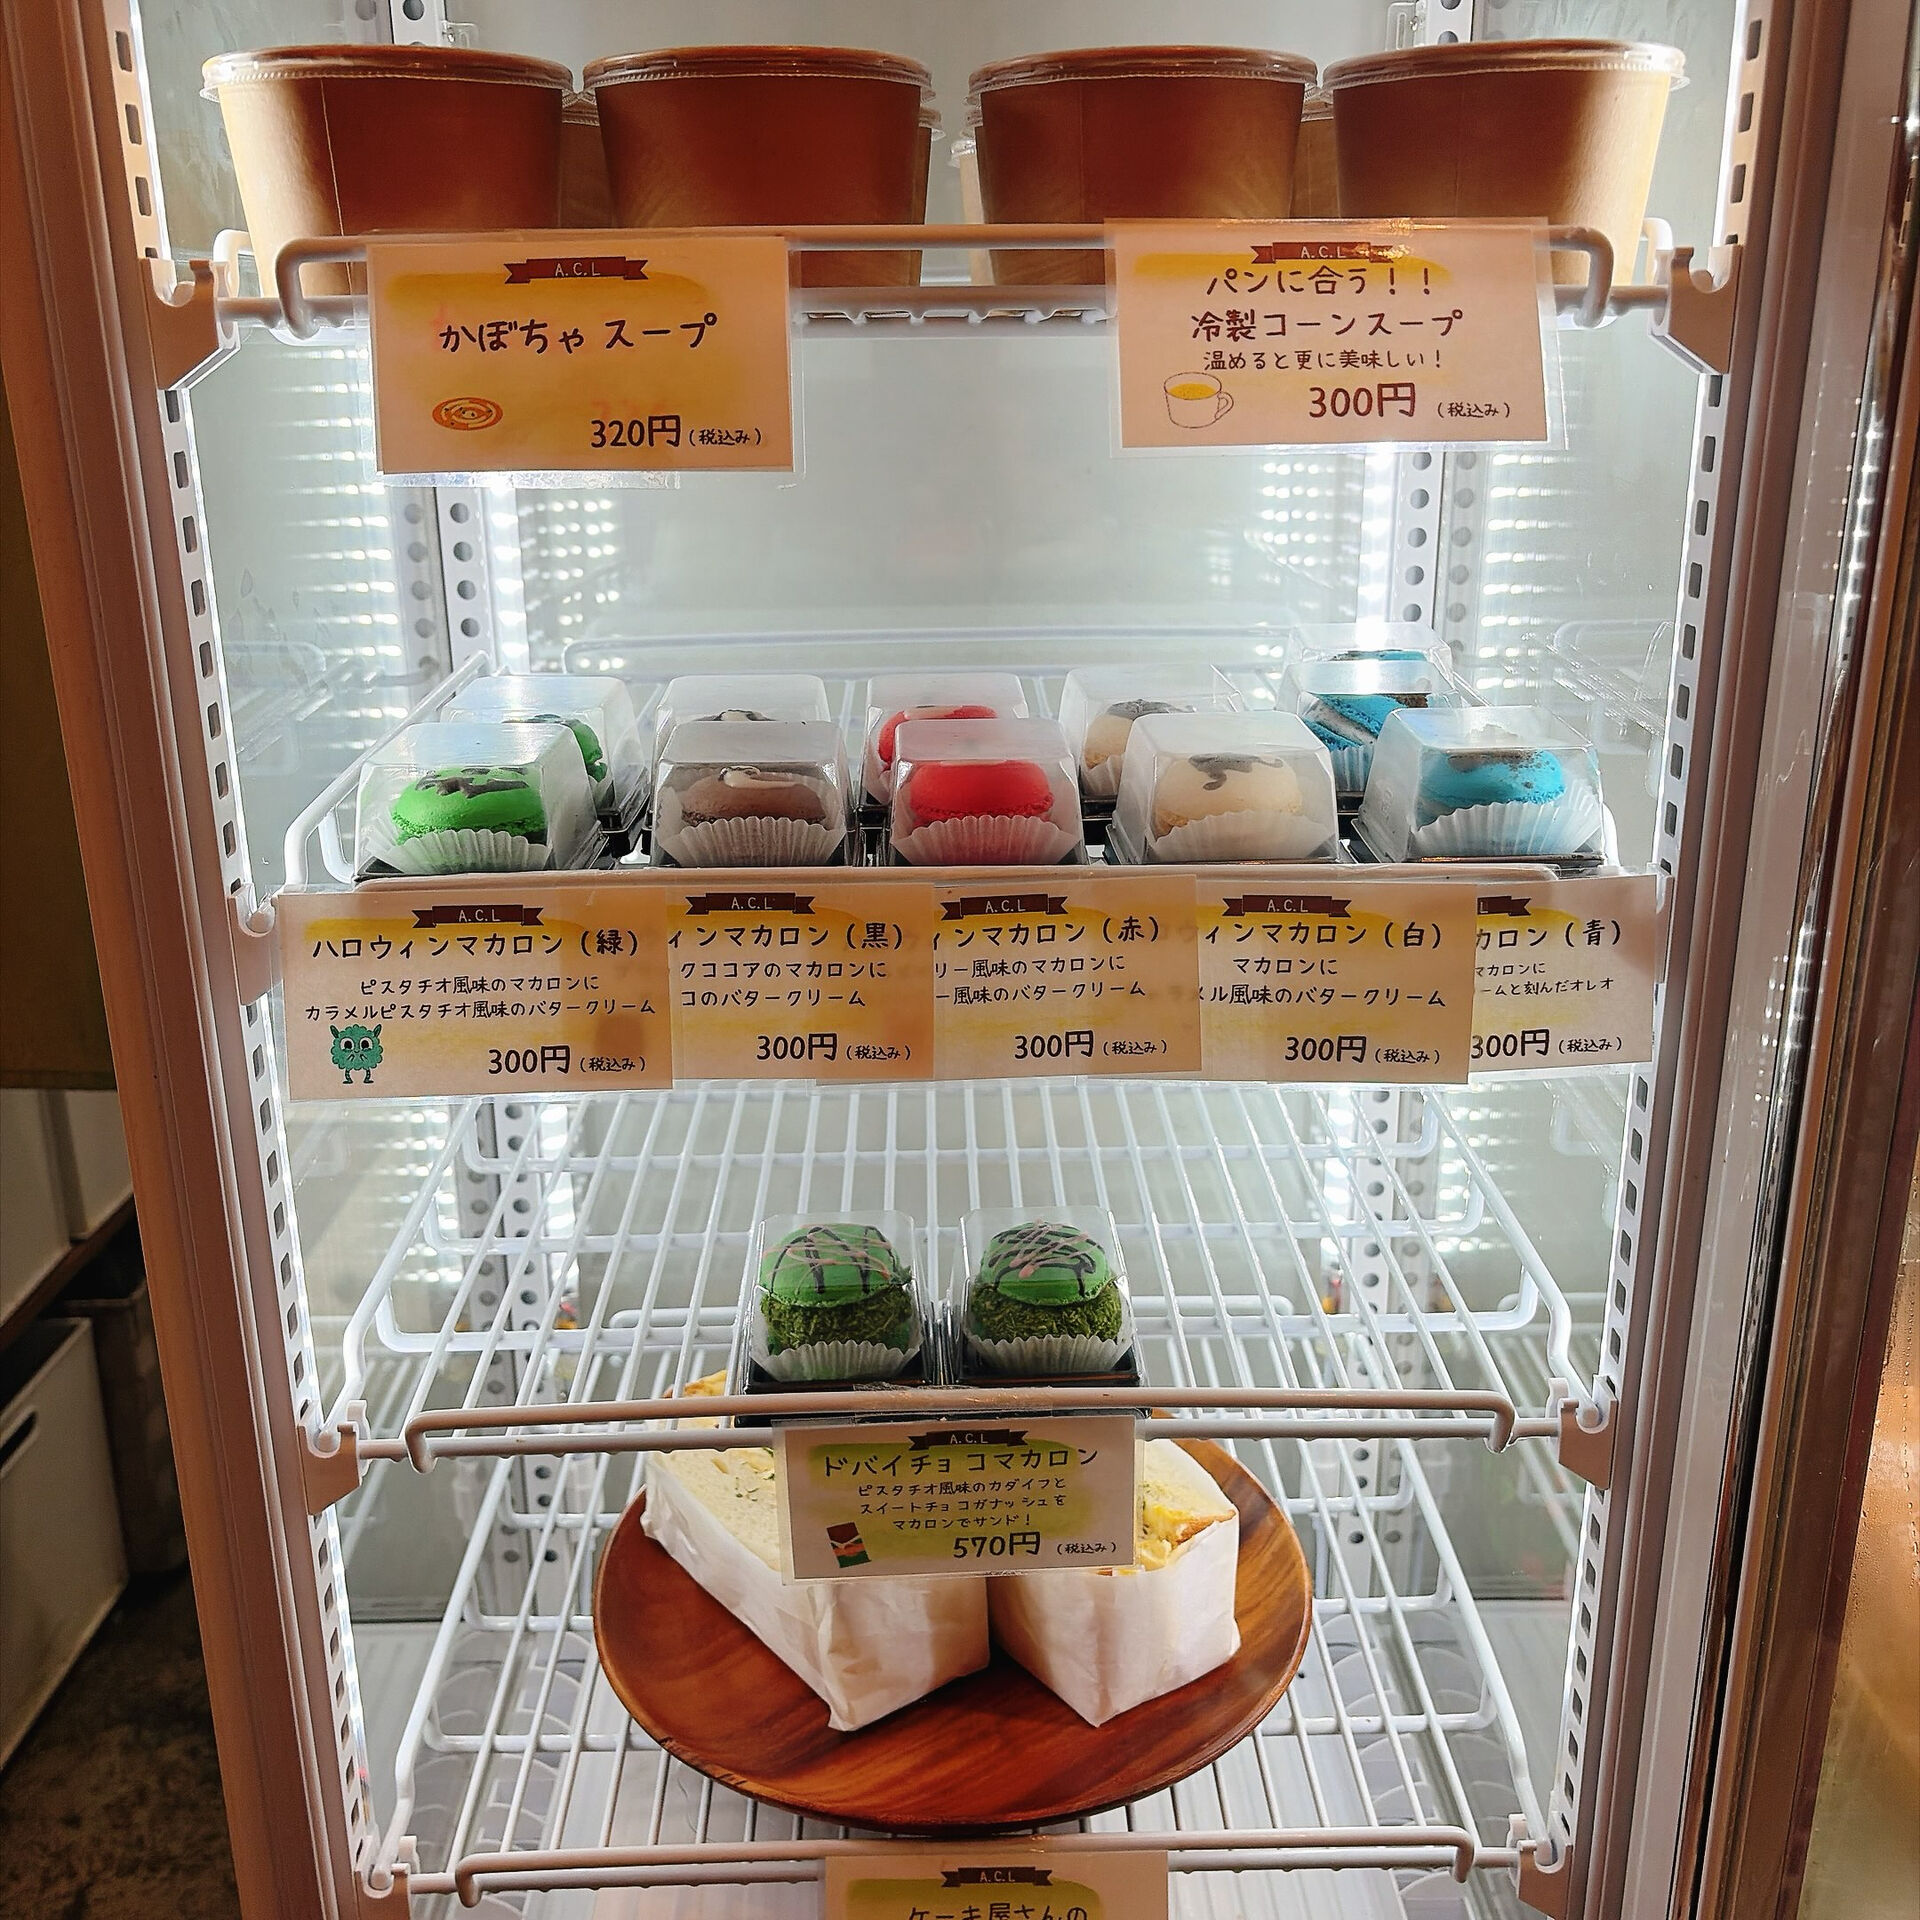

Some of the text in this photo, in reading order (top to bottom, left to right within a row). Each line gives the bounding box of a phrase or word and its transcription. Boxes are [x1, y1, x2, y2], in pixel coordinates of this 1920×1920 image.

[1300, 245, 1346, 259] A.C.L
[555, 262, 601, 278] A.C.L
[1206, 266, 1430, 296] パンに合う！！
[439, 312, 718, 354] かぼちゃスープ
[1191, 309, 1463, 342] 冷製コーンスープ
[1203, 349, 1442, 371] 温めると更に美味しい！
[1308, 382, 1510, 419] 300円 （税込み）
[590, 415, 761, 448] 320円 （税込み）
[731, 897, 773, 910] A.C.L
[985, 898, 1026, 913] A.C.L
[1267, 899, 1308, 913] A.C.L
[458, 909, 500, 923] A.C.L
[312, 929, 639, 960] ハロウィンマカロン（緑）
[681, 961, 887, 979] クココアのマカロンに
[935, 955, 1125, 979] リー風味のマカロンに
[1232, 956, 1338, 975] マカロンに
[360, 975, 599, 996] ピスタチオ風味のマカロンに
[936, 981, 1146, 1006] ー風味のバタークリーム
[1480, 978, 1614, 996] ームと刻んだオレオ
[682, 988, 865, 1007] コのバタークリーム
[305, 999, 655, 1021] カラメルピスタチオ風味のバタークリーム
[756, 1033, 911, 1061] 300円 （税込み）
[1014, 1029, 1167, 1059] 300円 （税込み）
[1284, 1035, 1440, 1064] 300円 （税込み）
[1470, 1028, 1622, 1059] 300円 （税込み）
[488, 1045, 645, 1075] 300円 （税込み）
[950, 1433, 989, 1444] A.C.L
[825, 1448, 1098, 1478] ドバイチョコマカロン
[859, 1477, 1065, 1497] ピスタチオ風味のカダイフと
[860, 1495, 1066, 1515] スイートチョコガナッシュを
[893, 1513, 1031, 1531] マカロンでサンド！
[953, 1531, 1117, 1559] 570円 （税込み）
[980, 1871, 1015, 1883] A.C.L
